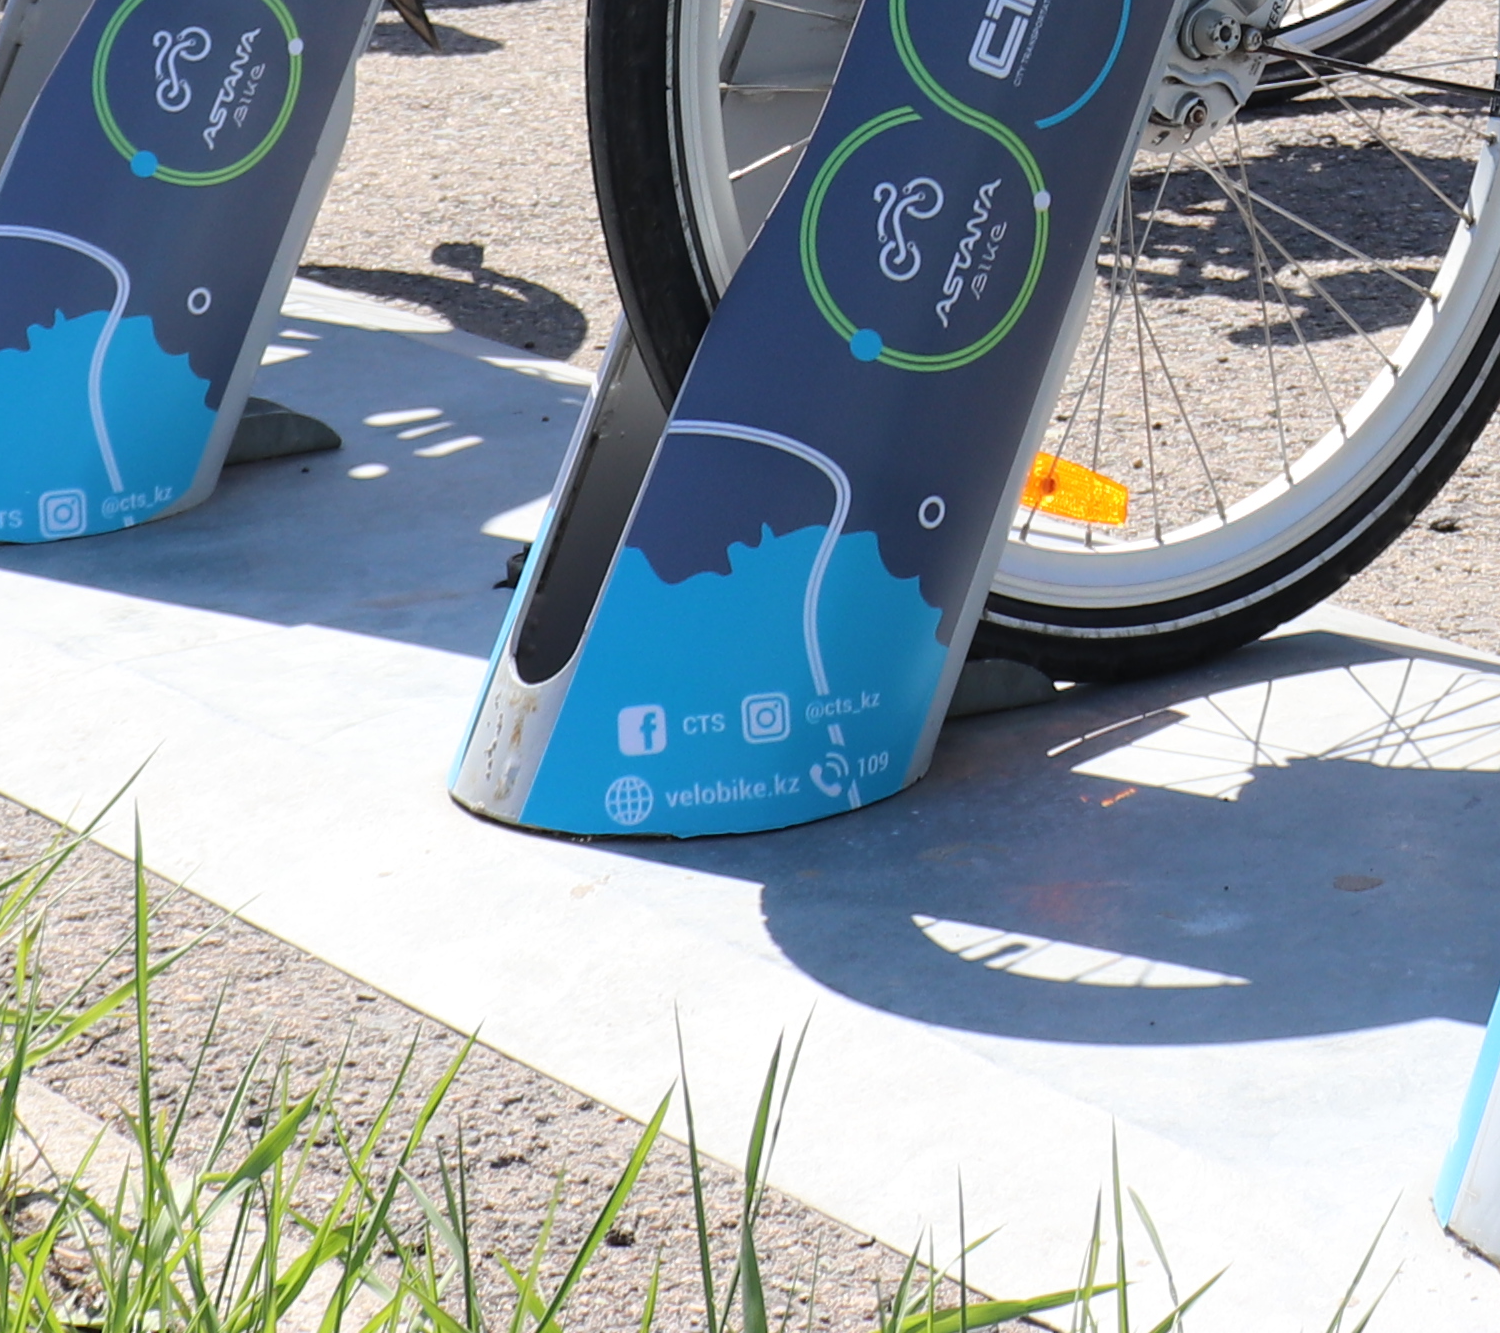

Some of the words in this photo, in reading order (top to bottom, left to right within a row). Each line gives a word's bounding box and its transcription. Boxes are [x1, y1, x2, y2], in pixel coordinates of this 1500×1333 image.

[203, 28, 261, 151] ASTANA
[1013, 63, 1029, 87] CITY
[936, 178, 1002, 328] ASTANA
[101, 485, 172, 517] @cts_kz
[683, 713, 726, 735] CTS
[806, 690, 880, 724] @cts_kz
[665, 774, 800, 809] velobike.kz
[857, 751, 889, 779] 109
